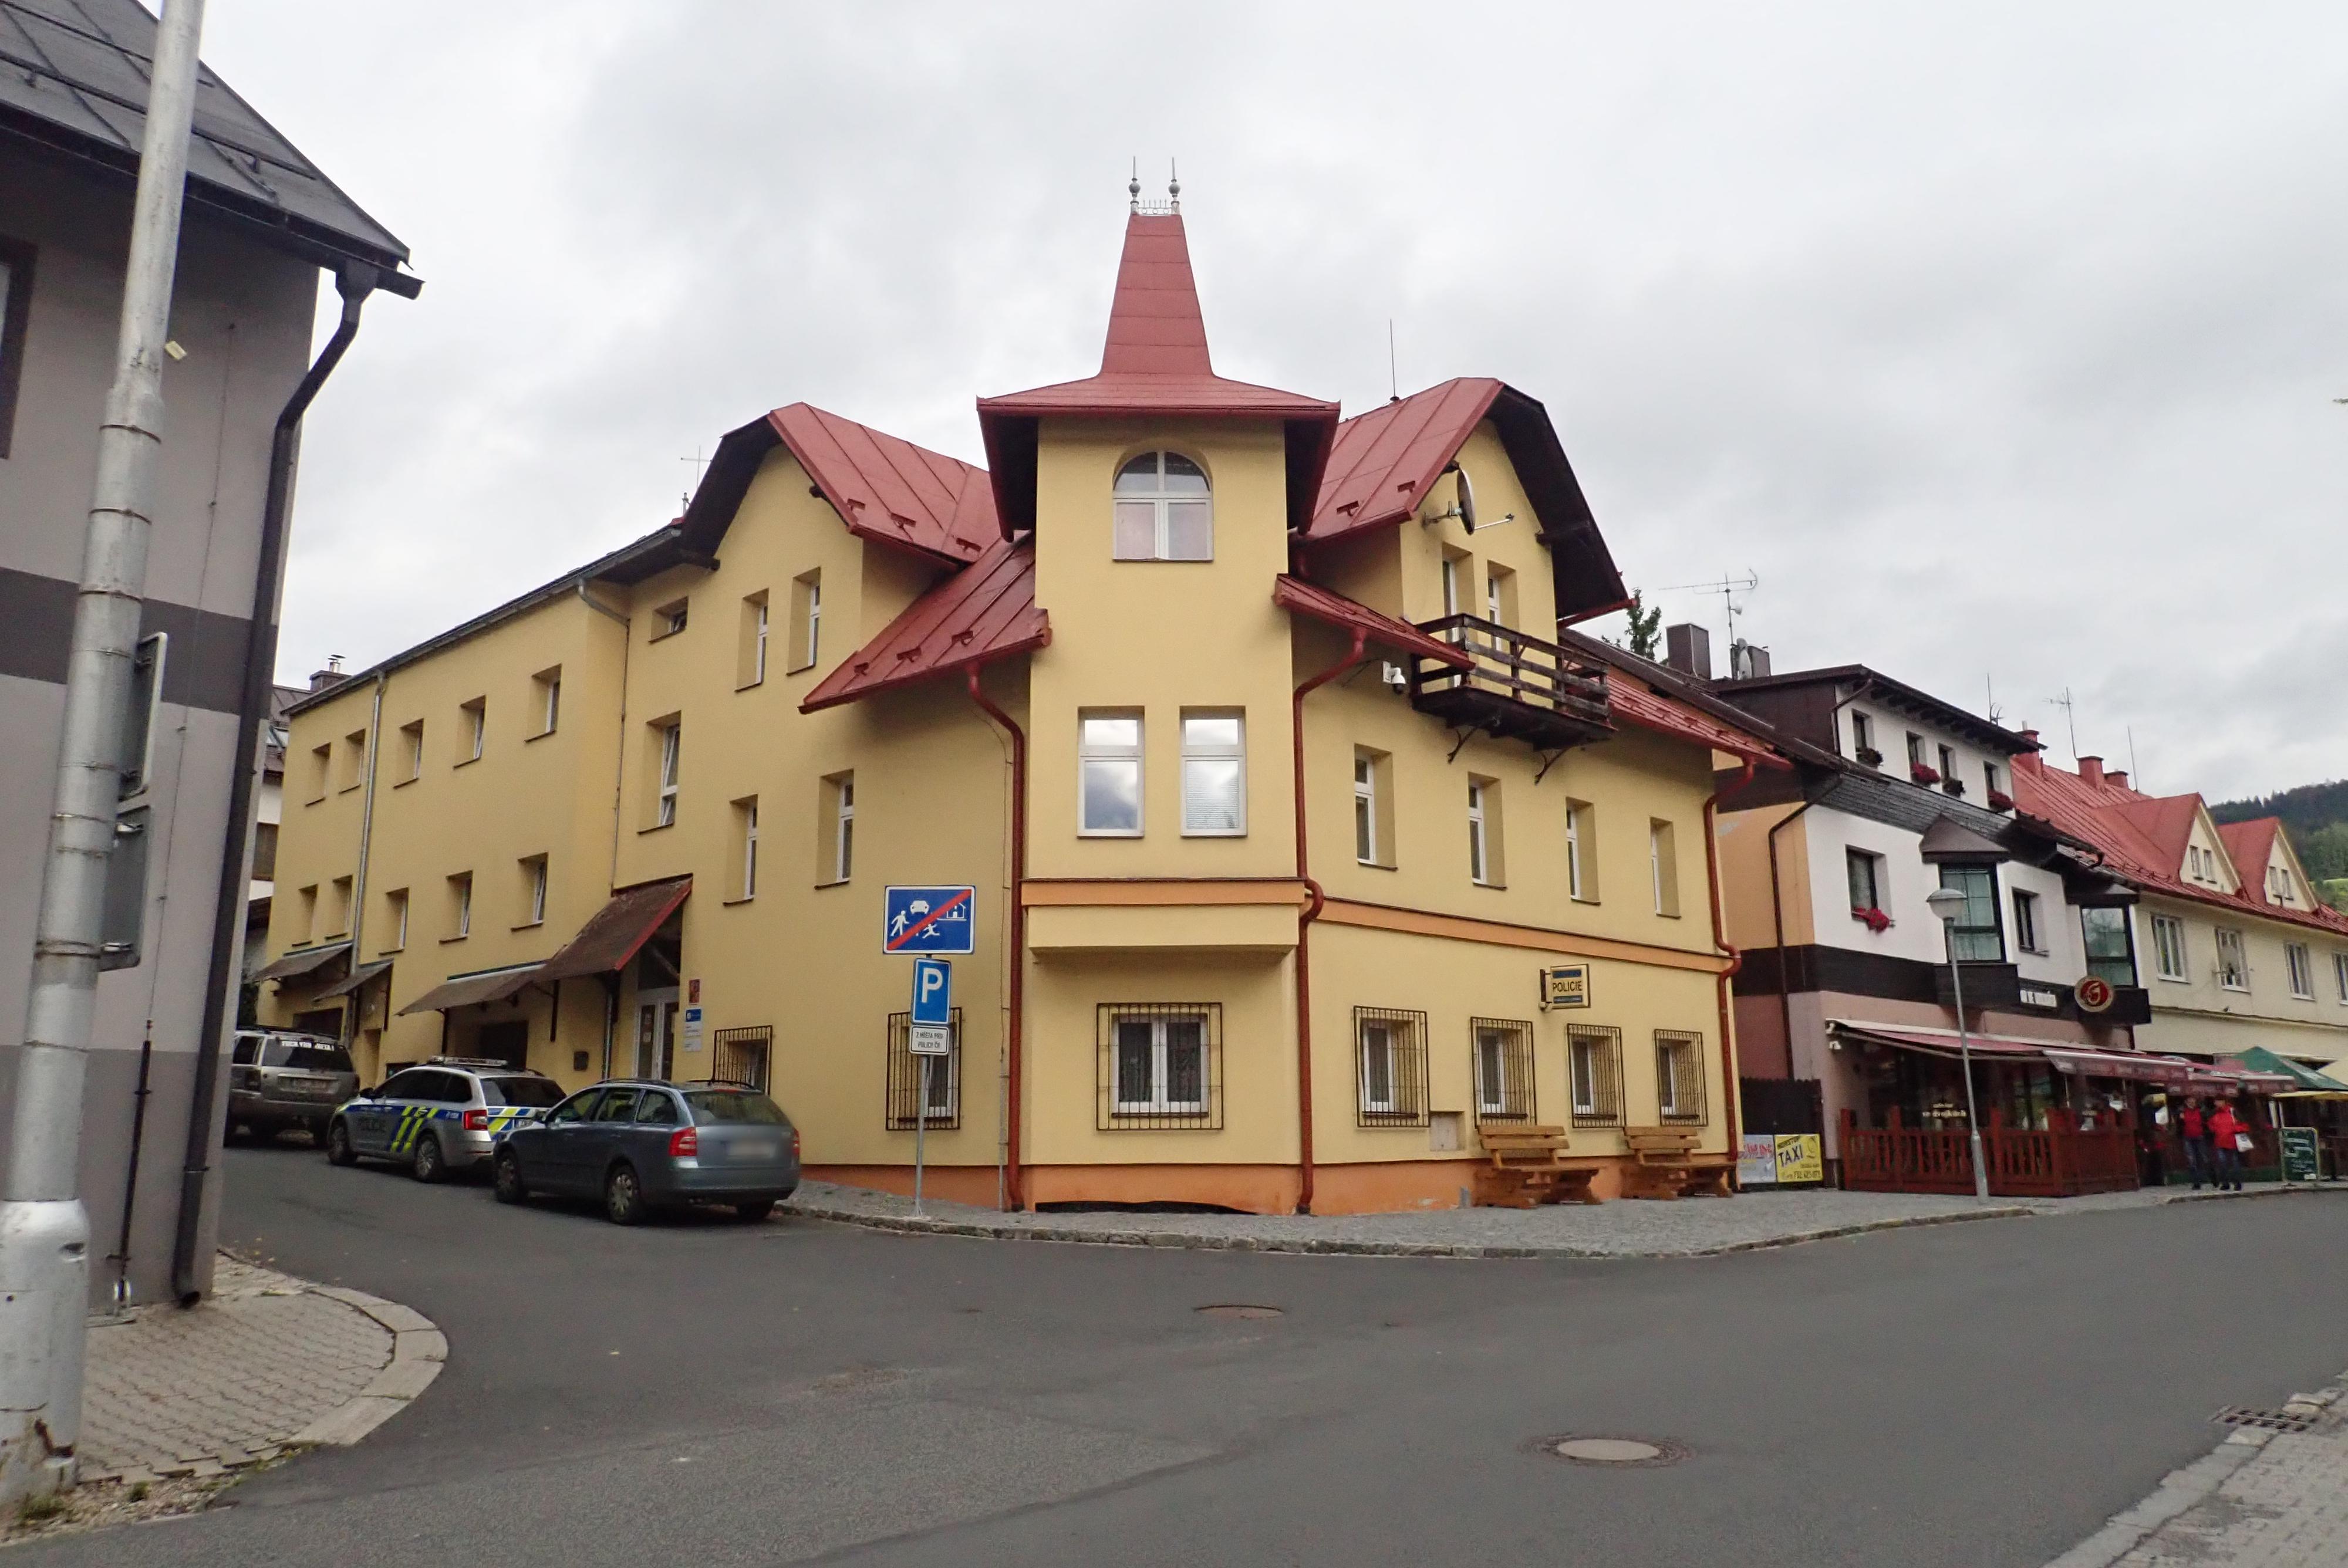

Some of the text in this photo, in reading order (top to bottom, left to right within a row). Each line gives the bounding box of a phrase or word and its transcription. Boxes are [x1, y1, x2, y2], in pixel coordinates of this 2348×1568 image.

[921, 968, 943, 1003] P
[1552, 981, 1583, 992] POLICIE
[1777, 1144, 1803, 1168] TAXI
